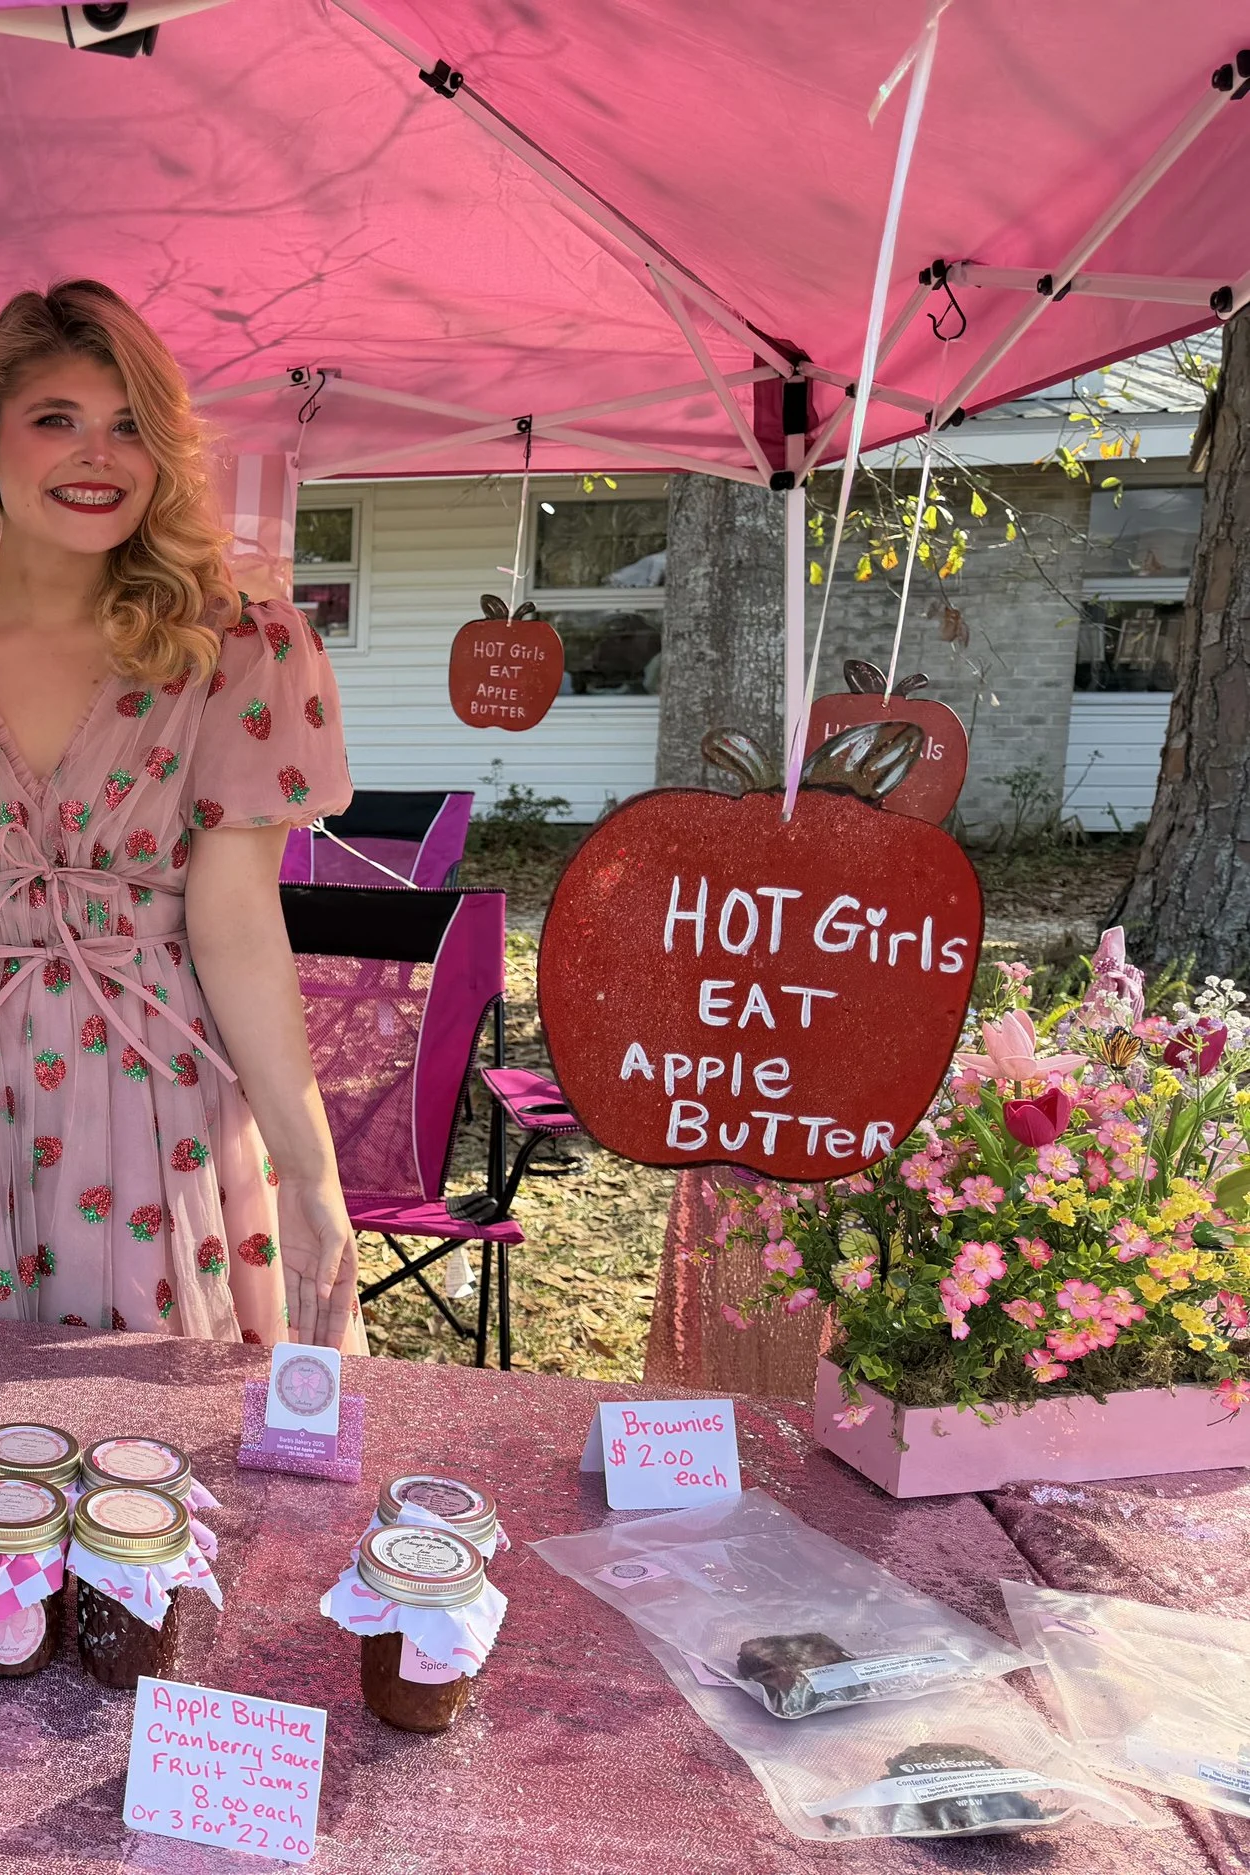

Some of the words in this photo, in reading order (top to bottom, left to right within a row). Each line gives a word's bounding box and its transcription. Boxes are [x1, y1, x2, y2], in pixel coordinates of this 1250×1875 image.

[474, 641, 505, 658] HOT
[510, 644, 545, 660] Girls
[490, 666, 523, 679] EAT
[477, 684, 518, 700] APPLE
[471, 701, 526, 718] BUTTER
[663, 875, 803, 957] HOT
[814, 895, 968, 974] Girls
[699, 980, 838, 1030] EAT
[620, 1042, 794, 1100] Apple
[622, 1410, 724, 1436] Brownies
[295, 1438, 311, 1447] Bakery
[608, 1438, 626, 1466] $
[638, 1444, 694, 1468] 2.00
[674, 1465, 727, 1488] each
[420, 1661, 448, 1672] Spice
[153, 1686, 222, 1726] Apple
[147, 1723, 263, 1769] Cranberry
[915, 1759, 986, 1771] FoodSaver
[239, 1766, 308, 1800] Jams
[191, 1785, 248, 1813] 8.00
[253, 1803, 303, 1828] each
[169, 1809, 183, 1829] 3
